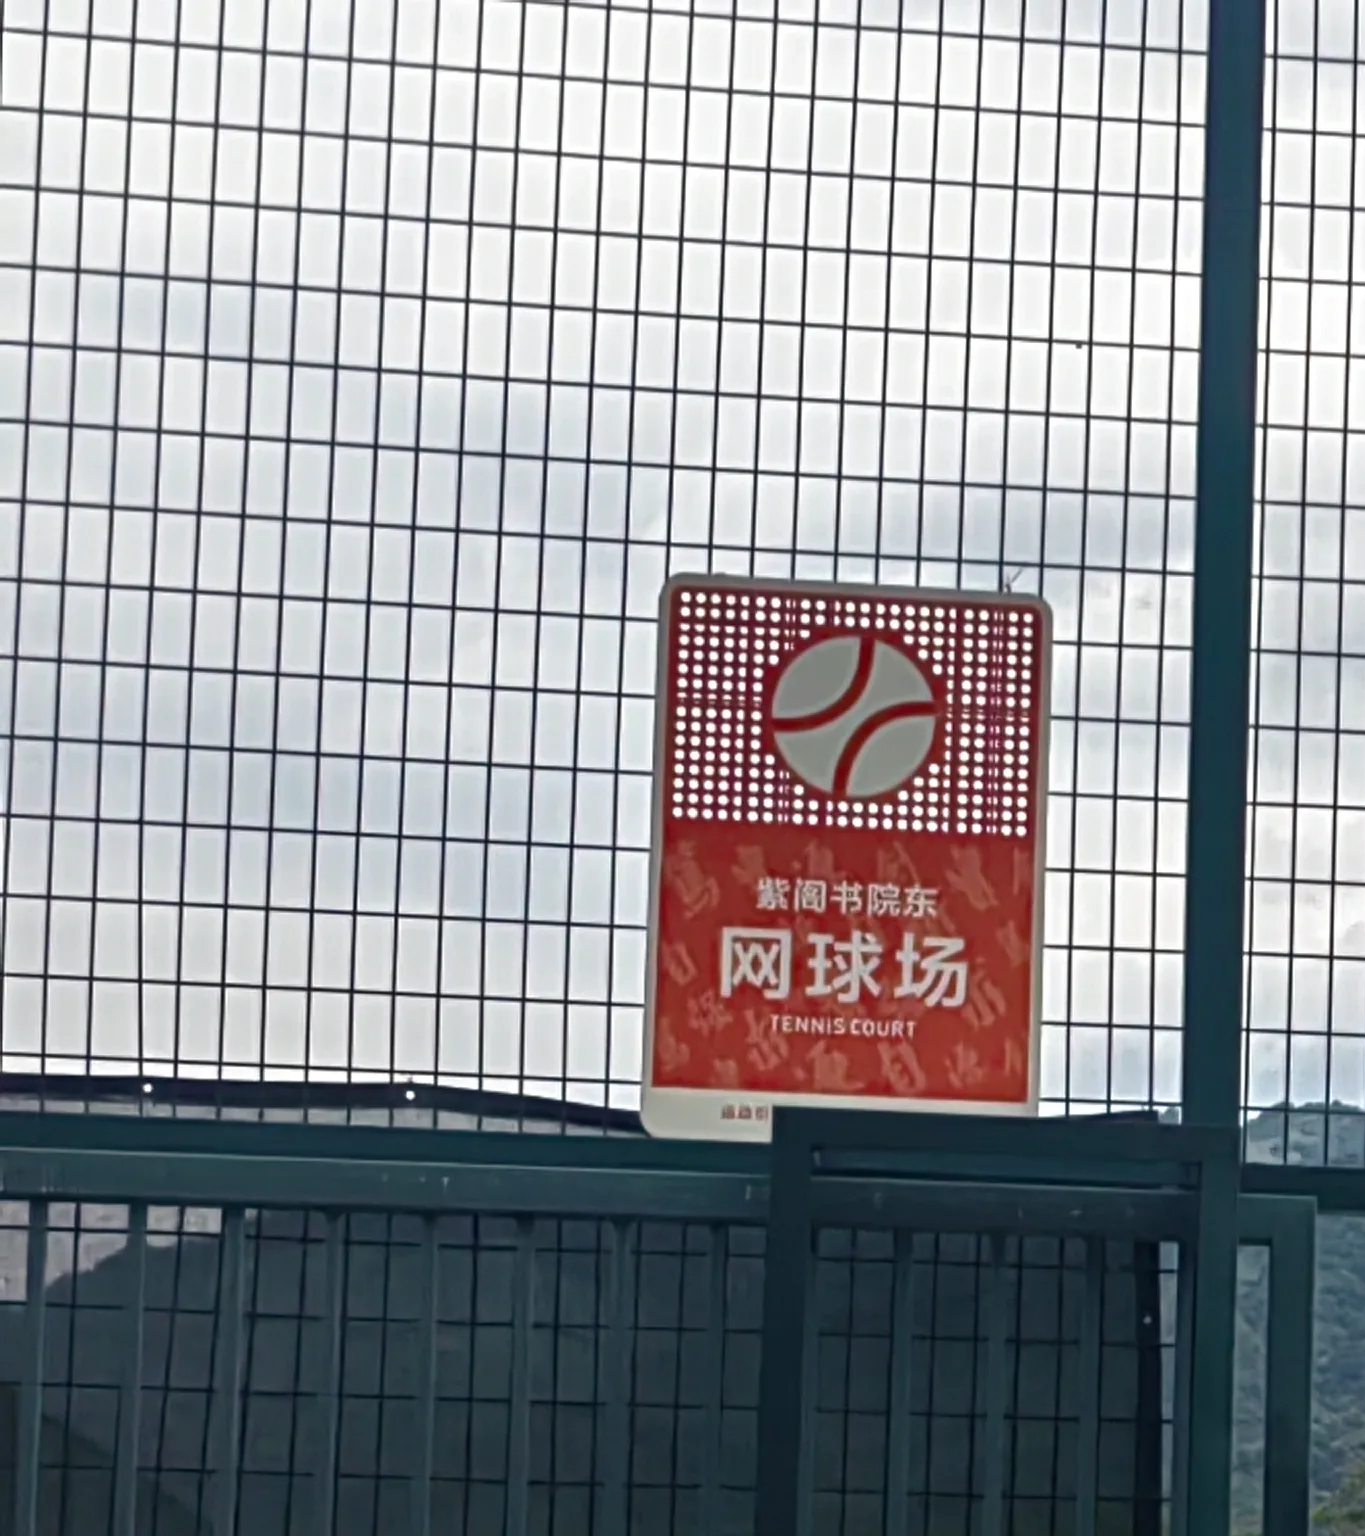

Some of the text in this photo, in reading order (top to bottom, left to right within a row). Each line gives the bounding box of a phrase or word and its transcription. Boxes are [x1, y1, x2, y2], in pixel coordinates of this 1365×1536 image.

[756, 876, 939, 917] 紫阁书院东
[720, 926, 968, 1007] 网球场
[770, 1014, 917, 1038] TENNIS COURT
